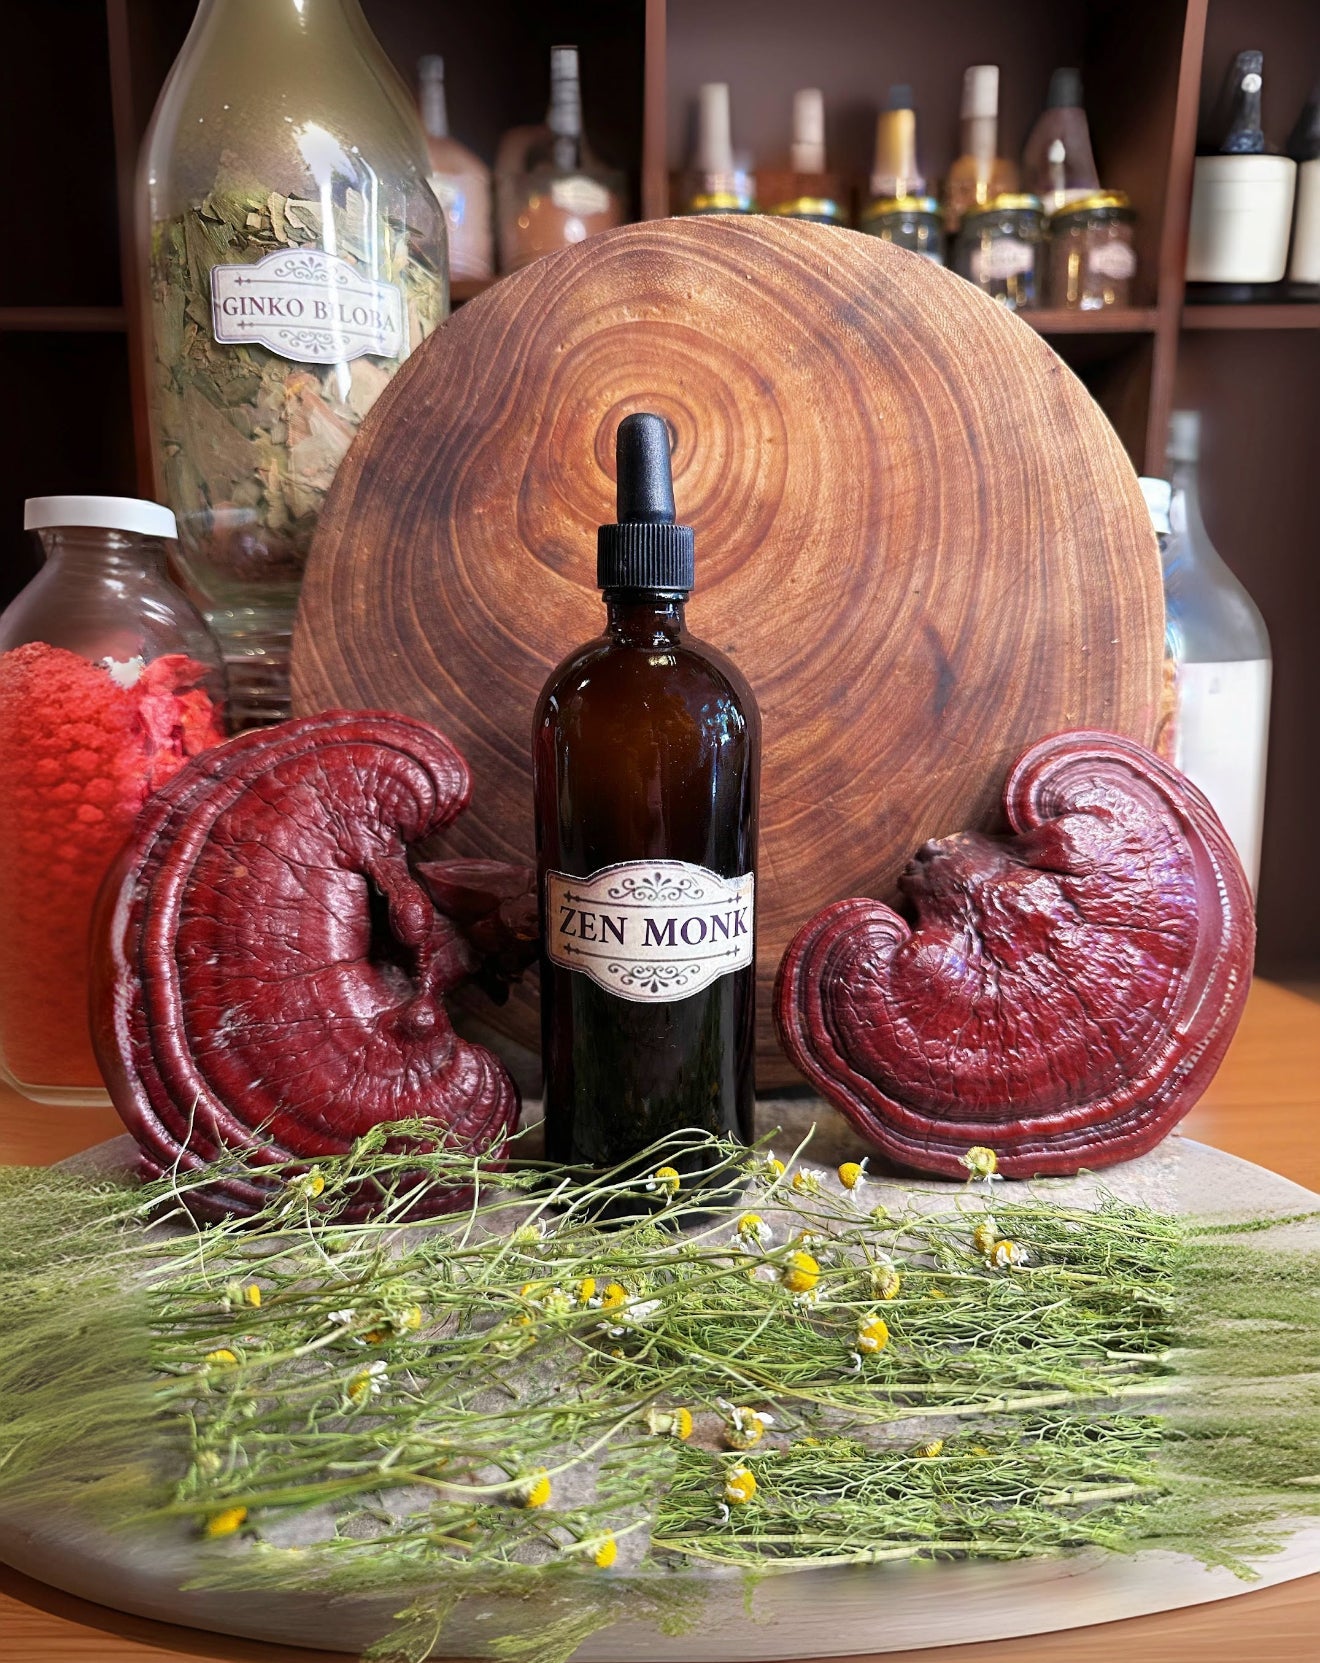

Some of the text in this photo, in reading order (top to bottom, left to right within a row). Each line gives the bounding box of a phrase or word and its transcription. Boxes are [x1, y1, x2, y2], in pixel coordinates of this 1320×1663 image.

[222, 297, 305, 318] GINKO
[559, 905, 749, 947] ZEN MONK
